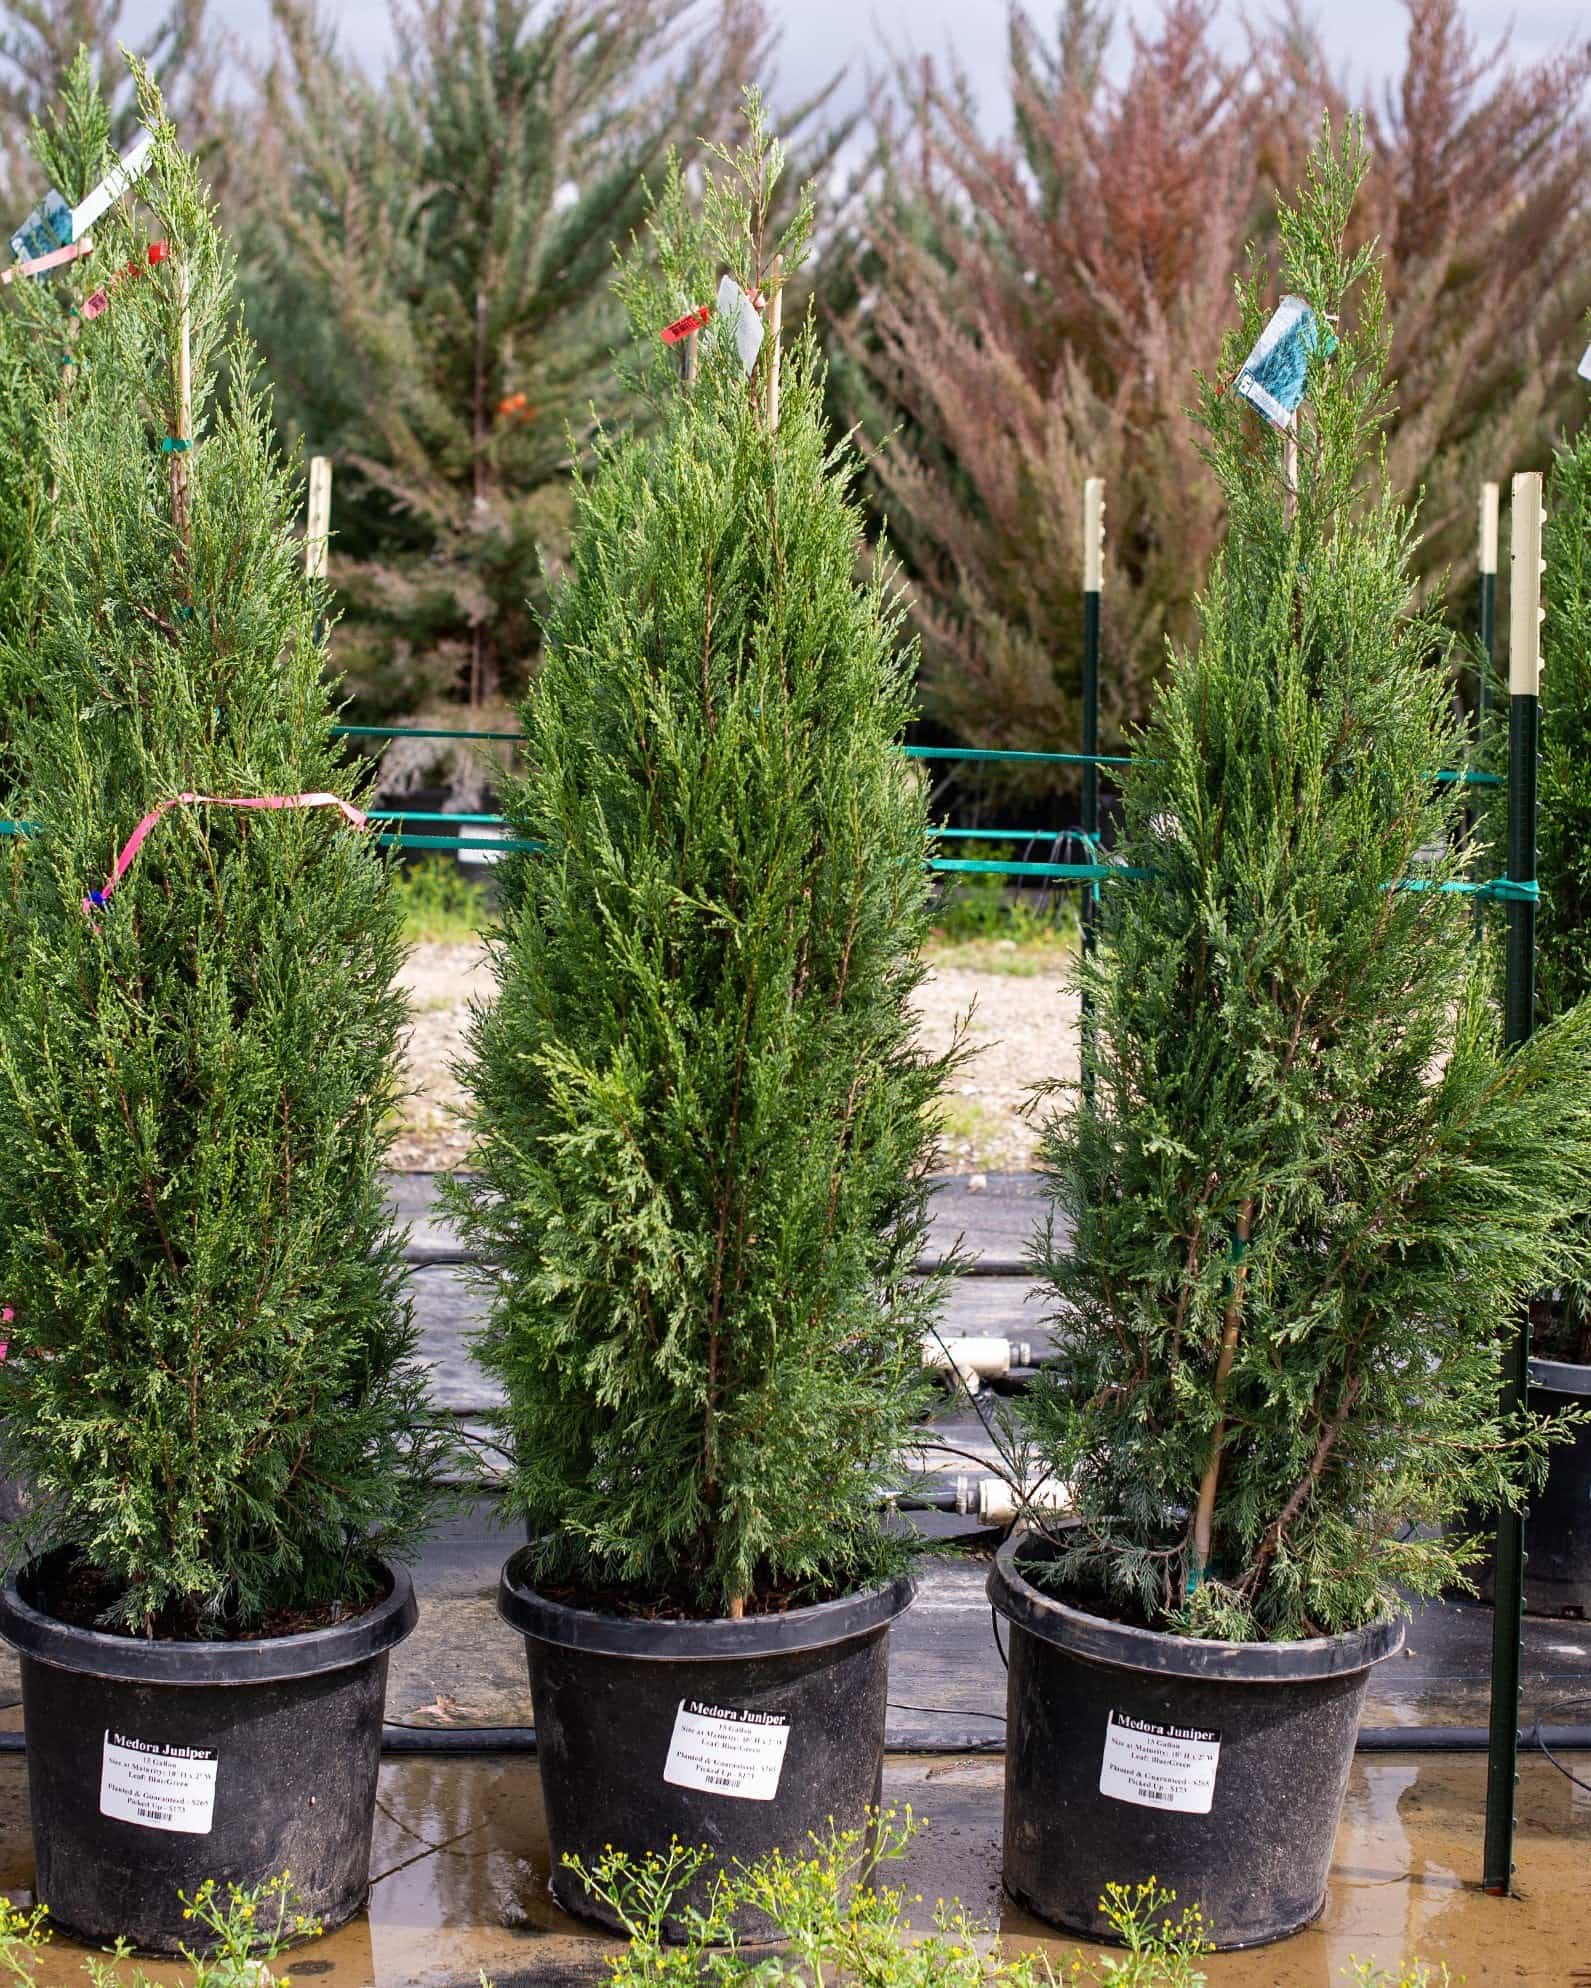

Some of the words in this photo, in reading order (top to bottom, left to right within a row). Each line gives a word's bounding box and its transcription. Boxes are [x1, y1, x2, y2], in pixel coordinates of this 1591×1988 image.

[689, 1701, 736, 1719] Medora
[740, 1710, 786, 1725] Juniper
[1118, 1714, 1164, 1734] Medora
[1167, 1725, 1215, 1741] Juniper
[114, 1733, 159, 1752] Medora
[163, 1745, 211, 1760] Juniper
[1111, 1737, 1125, 1746] Size
[1156, 1739, 1180, 1749] Gallon
[109, 1758, 121, 1766] Size
[152, 1759, 176, 1767] Gallon
[1109, 1764, 1135, 1775] Planted
[1144, 1773, 1187, 1785] Guaranteed
[1128, 1778, 1151, 1788] Picked
[1153, 1783, 1163, 1791] Up
[108, 1784, 133, 1795] Planted
[143, 1792, 184, 1804] Guaranteed
[127, 1798, 150, 1808] Picked
[152, 1802, 162, 1811] Up
